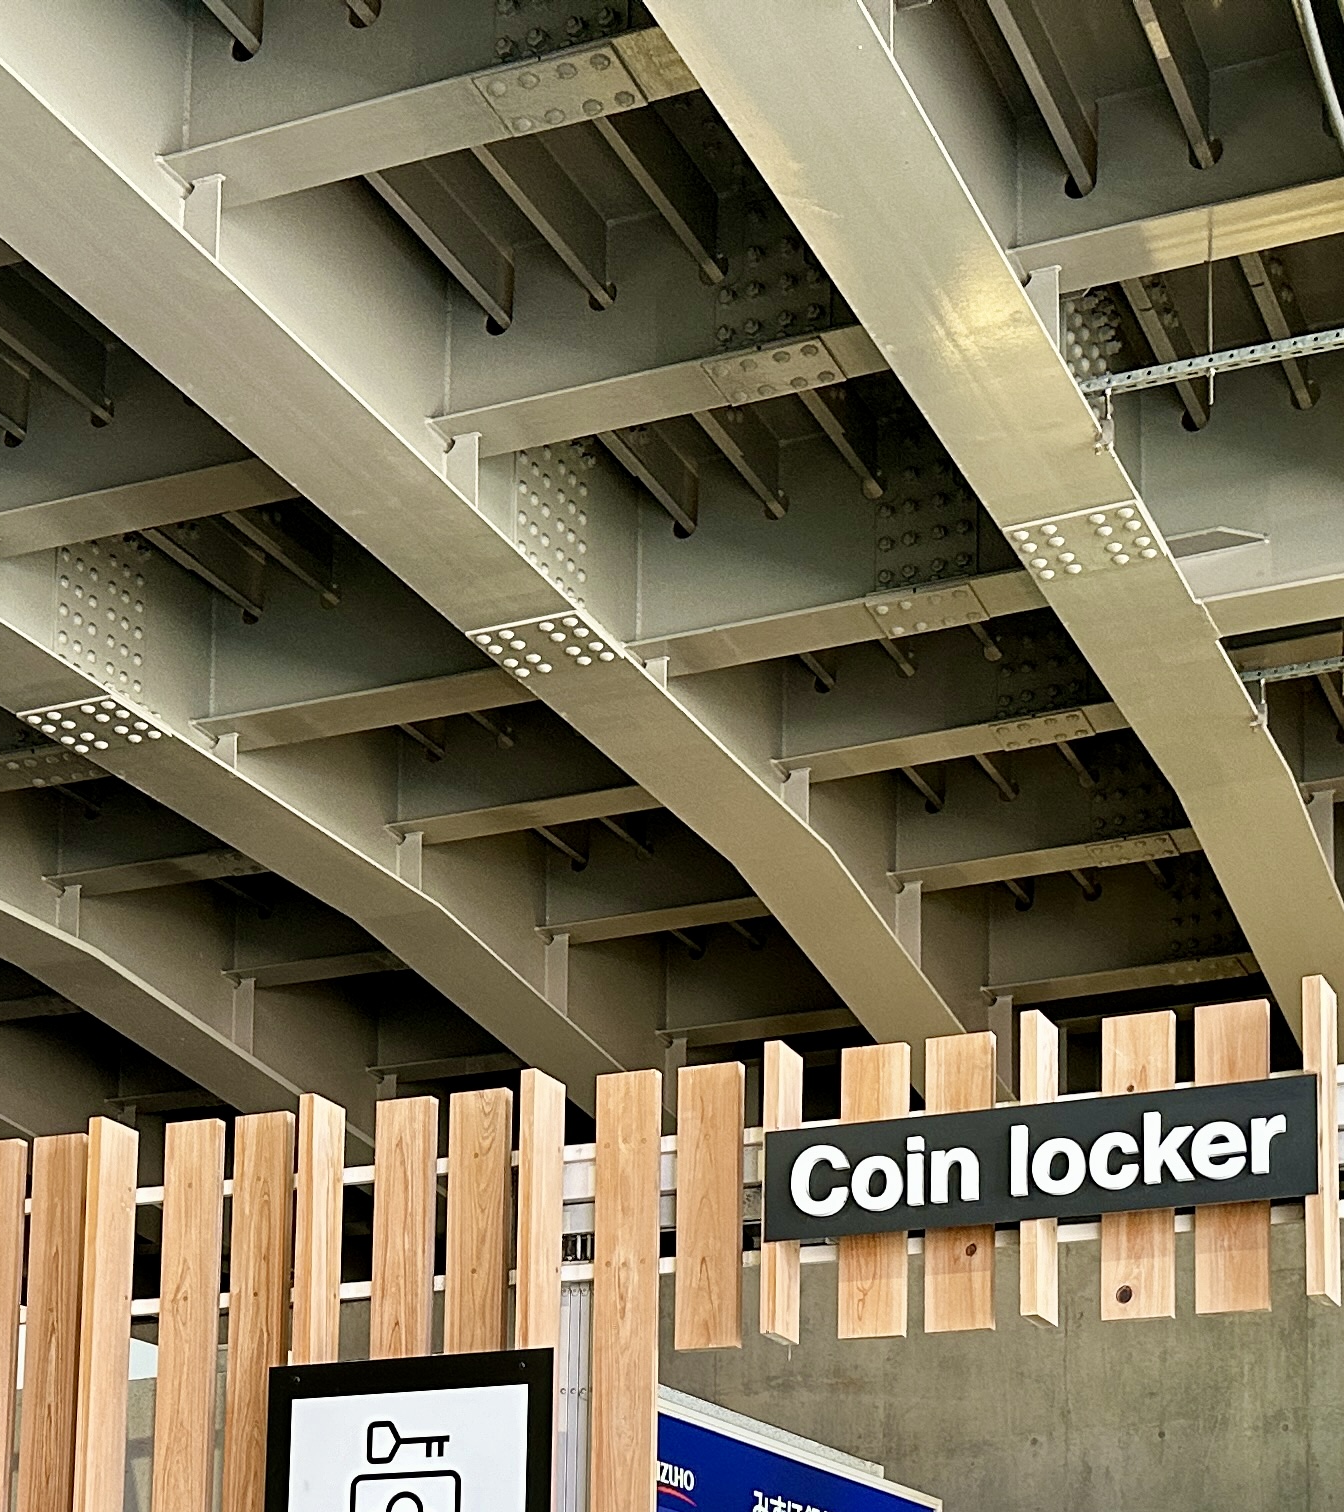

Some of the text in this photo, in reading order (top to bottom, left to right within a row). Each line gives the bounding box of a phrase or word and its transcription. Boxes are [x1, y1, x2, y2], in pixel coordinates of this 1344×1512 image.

[790, 1111, 1287, 1218] Coin locker
[657, 1462, 695, 1492] IZUHO
